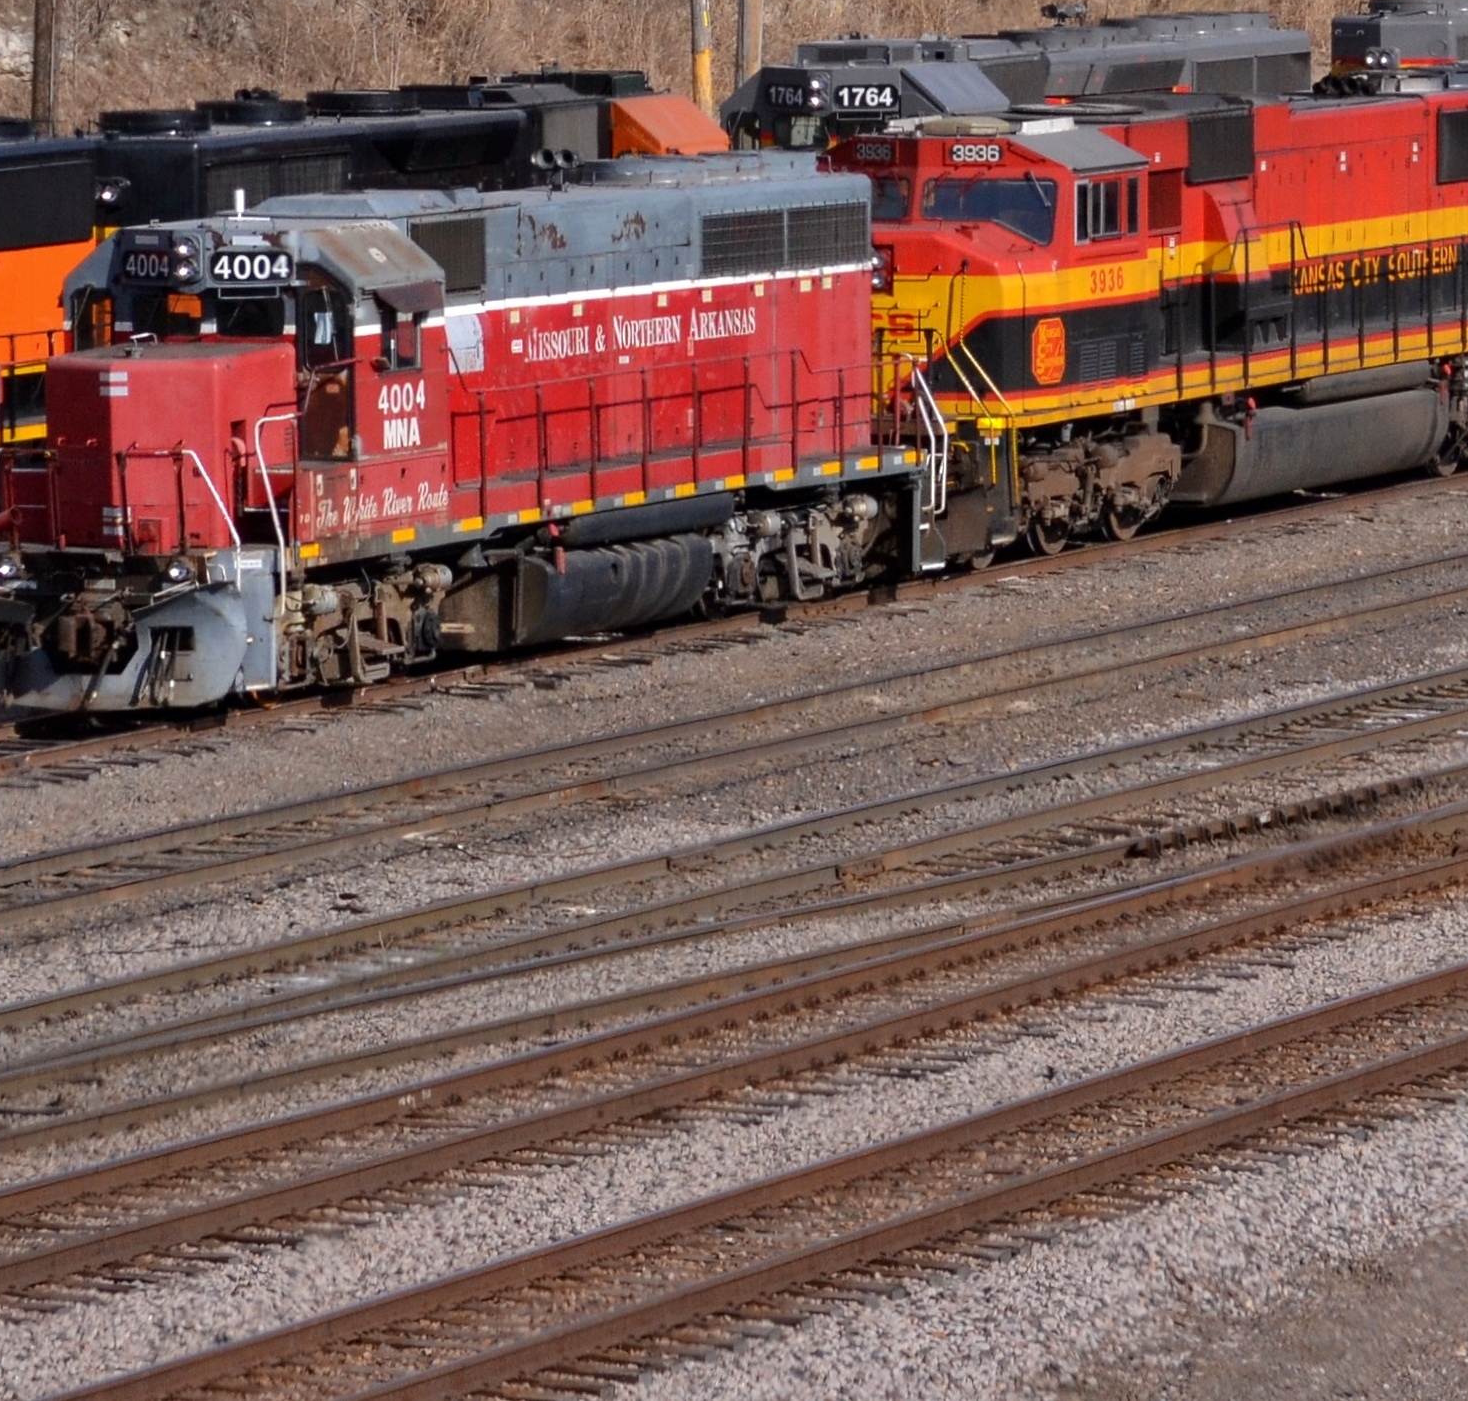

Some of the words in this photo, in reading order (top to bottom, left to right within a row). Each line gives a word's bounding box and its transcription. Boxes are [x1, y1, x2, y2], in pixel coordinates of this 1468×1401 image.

[769, 86, 803, 106] 1764
[838, 87, 893, 106] 1764
[856, 143, 892, 160] 3936
[952, 144, 1000, 162] 3936
[125, 254, 169, 277] 4004
[213, 254, 290, 280] 4004
[1351, 256, 1381, 286] CTY
[1090, 266, 1124, 294] 3936
[524, 326, 589, 363] MISSOURI
[595, 324, 606, 352] &
[612, 315, 682, 350] NORTHERN
[689, 307, 756, 341] ARKANSAS
[378, 379, 425, 415] 4004
[384, 417, 421, 450] MNA
[317, 499, 339, 528] The
[343, 493, 378, 525] White
[383, 487, 413, 516] River
[417, 481, 450, 511] Route
